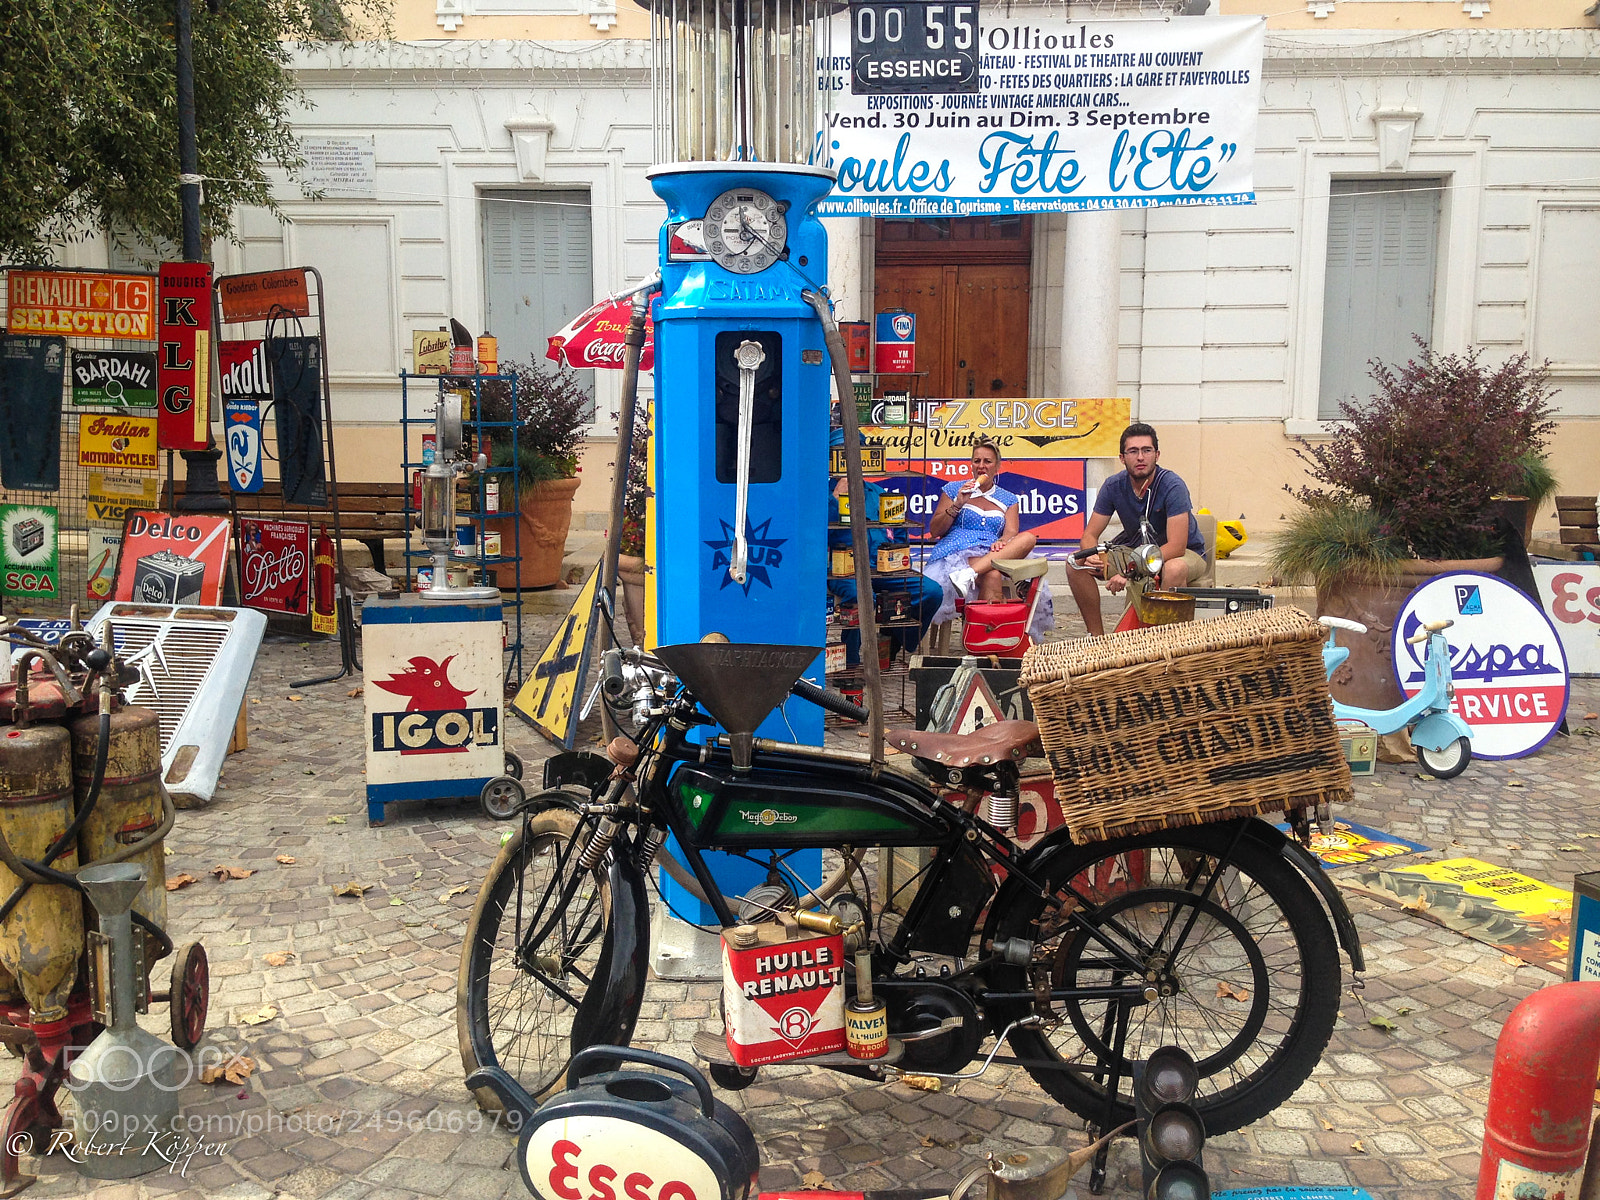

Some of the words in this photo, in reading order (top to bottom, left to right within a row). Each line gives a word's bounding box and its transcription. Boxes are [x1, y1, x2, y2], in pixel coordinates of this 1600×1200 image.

[867, 59, 962, 79] ESSENCE
[1024, 54, 1071, 69] FESTIVAL
[1074, 54, 1088, 68] DE
[1091, 53, 1136, 68] THEATRE
[1138, 53, 1153, 66] AU
[1155, 52, 1203, 67] COUVENT
[1000, 74, 1030, 89] FETES
[1032, 74, 1051, 88] DES
[1054, 73, 1113, 89] QUARTIERS
[1120, 73, 1133, 87] LA
[1136, 72, 1163, 86] GARE
[1165, 72, 1176, 86] ET
[1179, 70, 1250, 86] FAVEYROLLES
[867, 95, 934, 110] EXPOSITIONS
[941, 92, 987, 110] JOURNÉE
[990, 94, 1034, 109] VINTAGE
[1036, 93, 1090, 108] AMERICAN
[825, 112, 887, 128] Vend.
[893, 112, 920, 128] 30
[925, 111, 970, 128] Juin
[976, 115, 1002, 128] au
[1010, 111, 1061, 128] Dim.
[1067, 111, 1080, 127] 3
[1086, 108, 1210, 130] Septembre
[978, 130, 1087, 194] Fête
[818, 198, 902, 214] www.ollioules.fr
[909, 198, 938, 214] Office
[940, 199, 953, 213] de
[955, 200, 1001, 214] Tourisme
[1014, 199, 1079, 212] Réservations
[163, 277, 206, 288] BOUGIES
[226, 282, 258, 295] Goodrich
[262, 276, 299, 290] Colombes
[707, 279, 795, 301] SATAM
[13, 276, 94, 308] RENAULT
[114, 281, 148, 311] 16
[11, 308, 149, 336] SELECTION
[896, 321, 911, 331] FINA
[418, 337, 448, 356] Lubrilux
[898, 350, 909, 358] YM
[75, 358, 151, 388] BARDAHL
[978, 401, 1078, 430] SERGE
[88, 417, 150, 438] Indian
[865, 433, 924, 453] arage
[81, 451, 156, 467] MOTORCYCLES
[129, 515, 202, 541] Delco
[3, 564, 54, 572] ACCUMULATEURS
[711, 548, 783, 571] AUR
[245, 544, 305, 600] Dolle
[142, 582, 163, 599] Delco
[1457, 587, 1468, 606] P
[1066, 665, 1294, 735] CHAMPAGNE
[1449, 693, 1550, 719] ERVICE
[383, 711, 494, 749] IGOL
[755, 947, 829, 974] HUILE
[743, 966, 842, 998] RENAULT
[847, 1016, 885, 1030] VALVEX
[1231, 1189, 1262, 1198] prenez
[1266, 1187, 1282, 1195] pas
